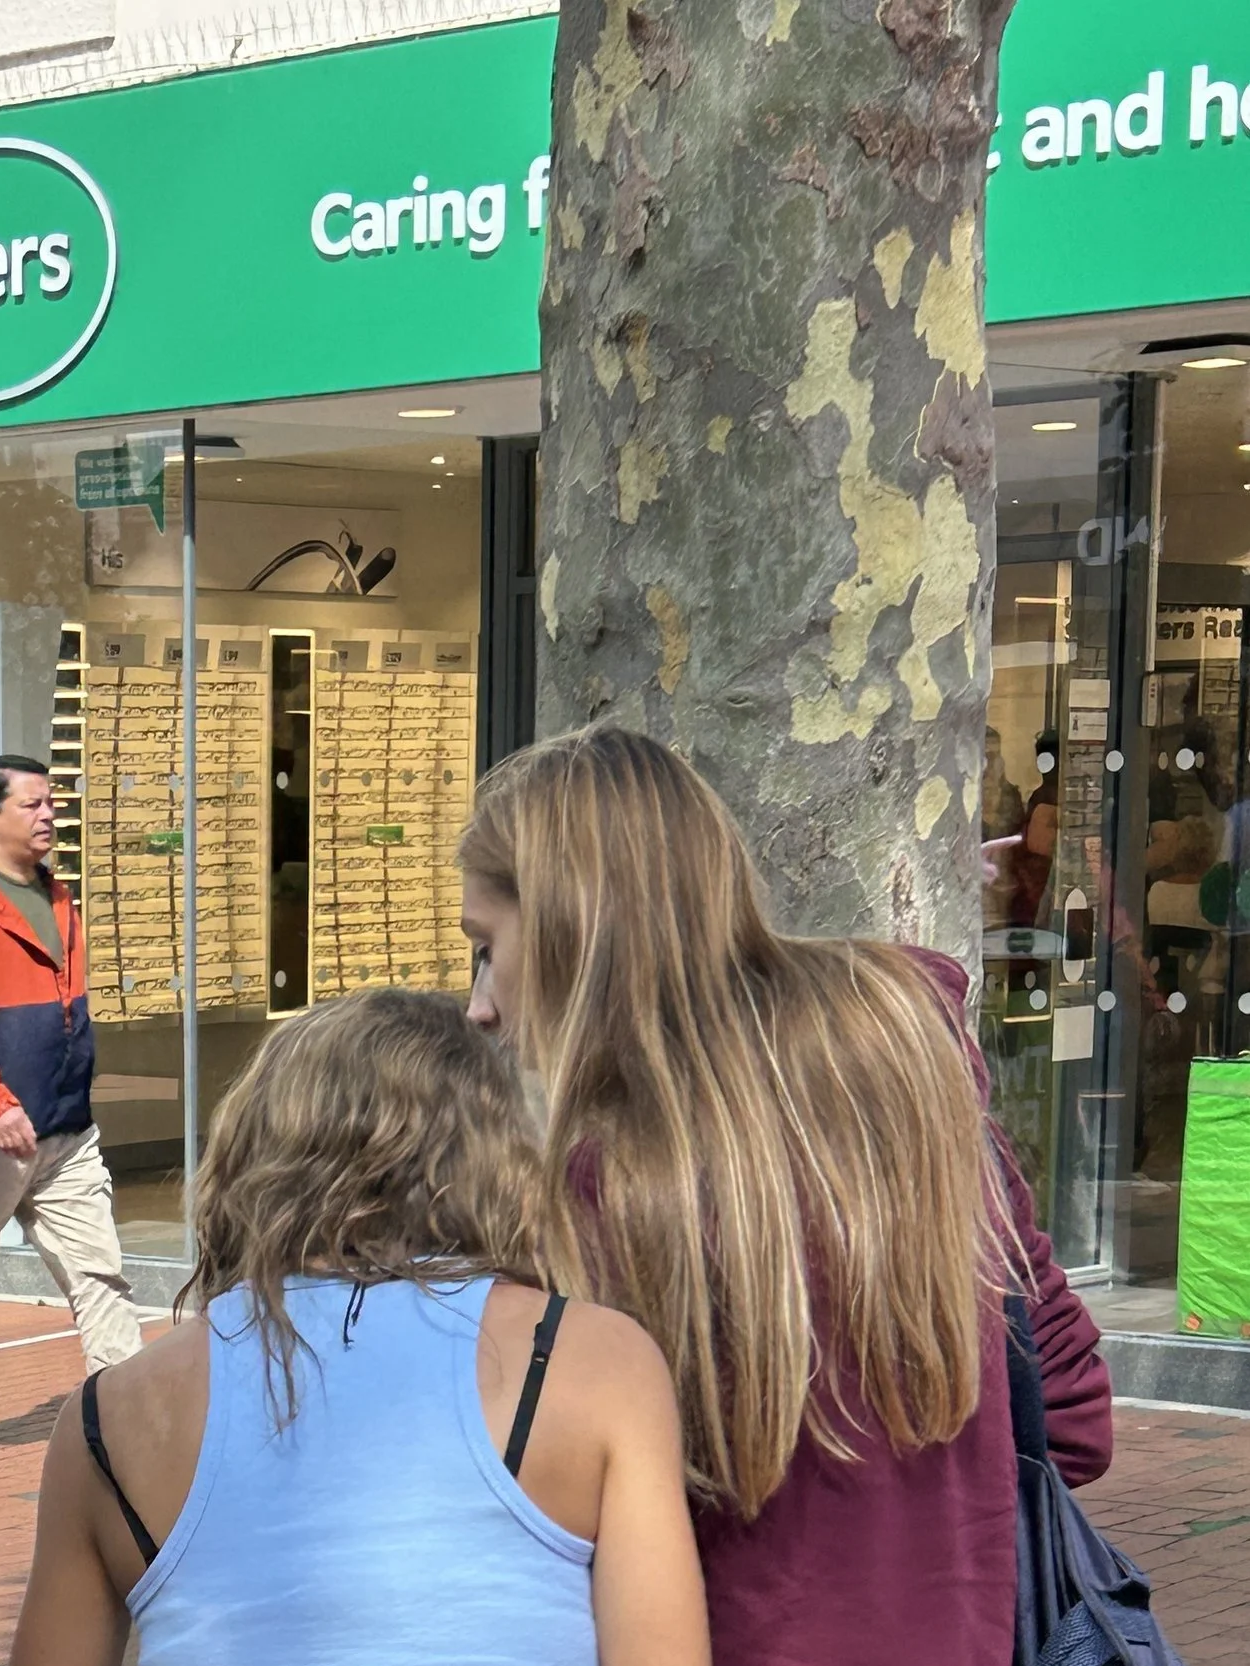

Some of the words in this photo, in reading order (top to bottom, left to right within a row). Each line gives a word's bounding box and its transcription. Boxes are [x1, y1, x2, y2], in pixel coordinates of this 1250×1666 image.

[311, 175, 506, 255] Caring
[522, 155, 550, 228] f
[1022, 70, 1164, 162] and
[1189, 64, 1250, 142] h
